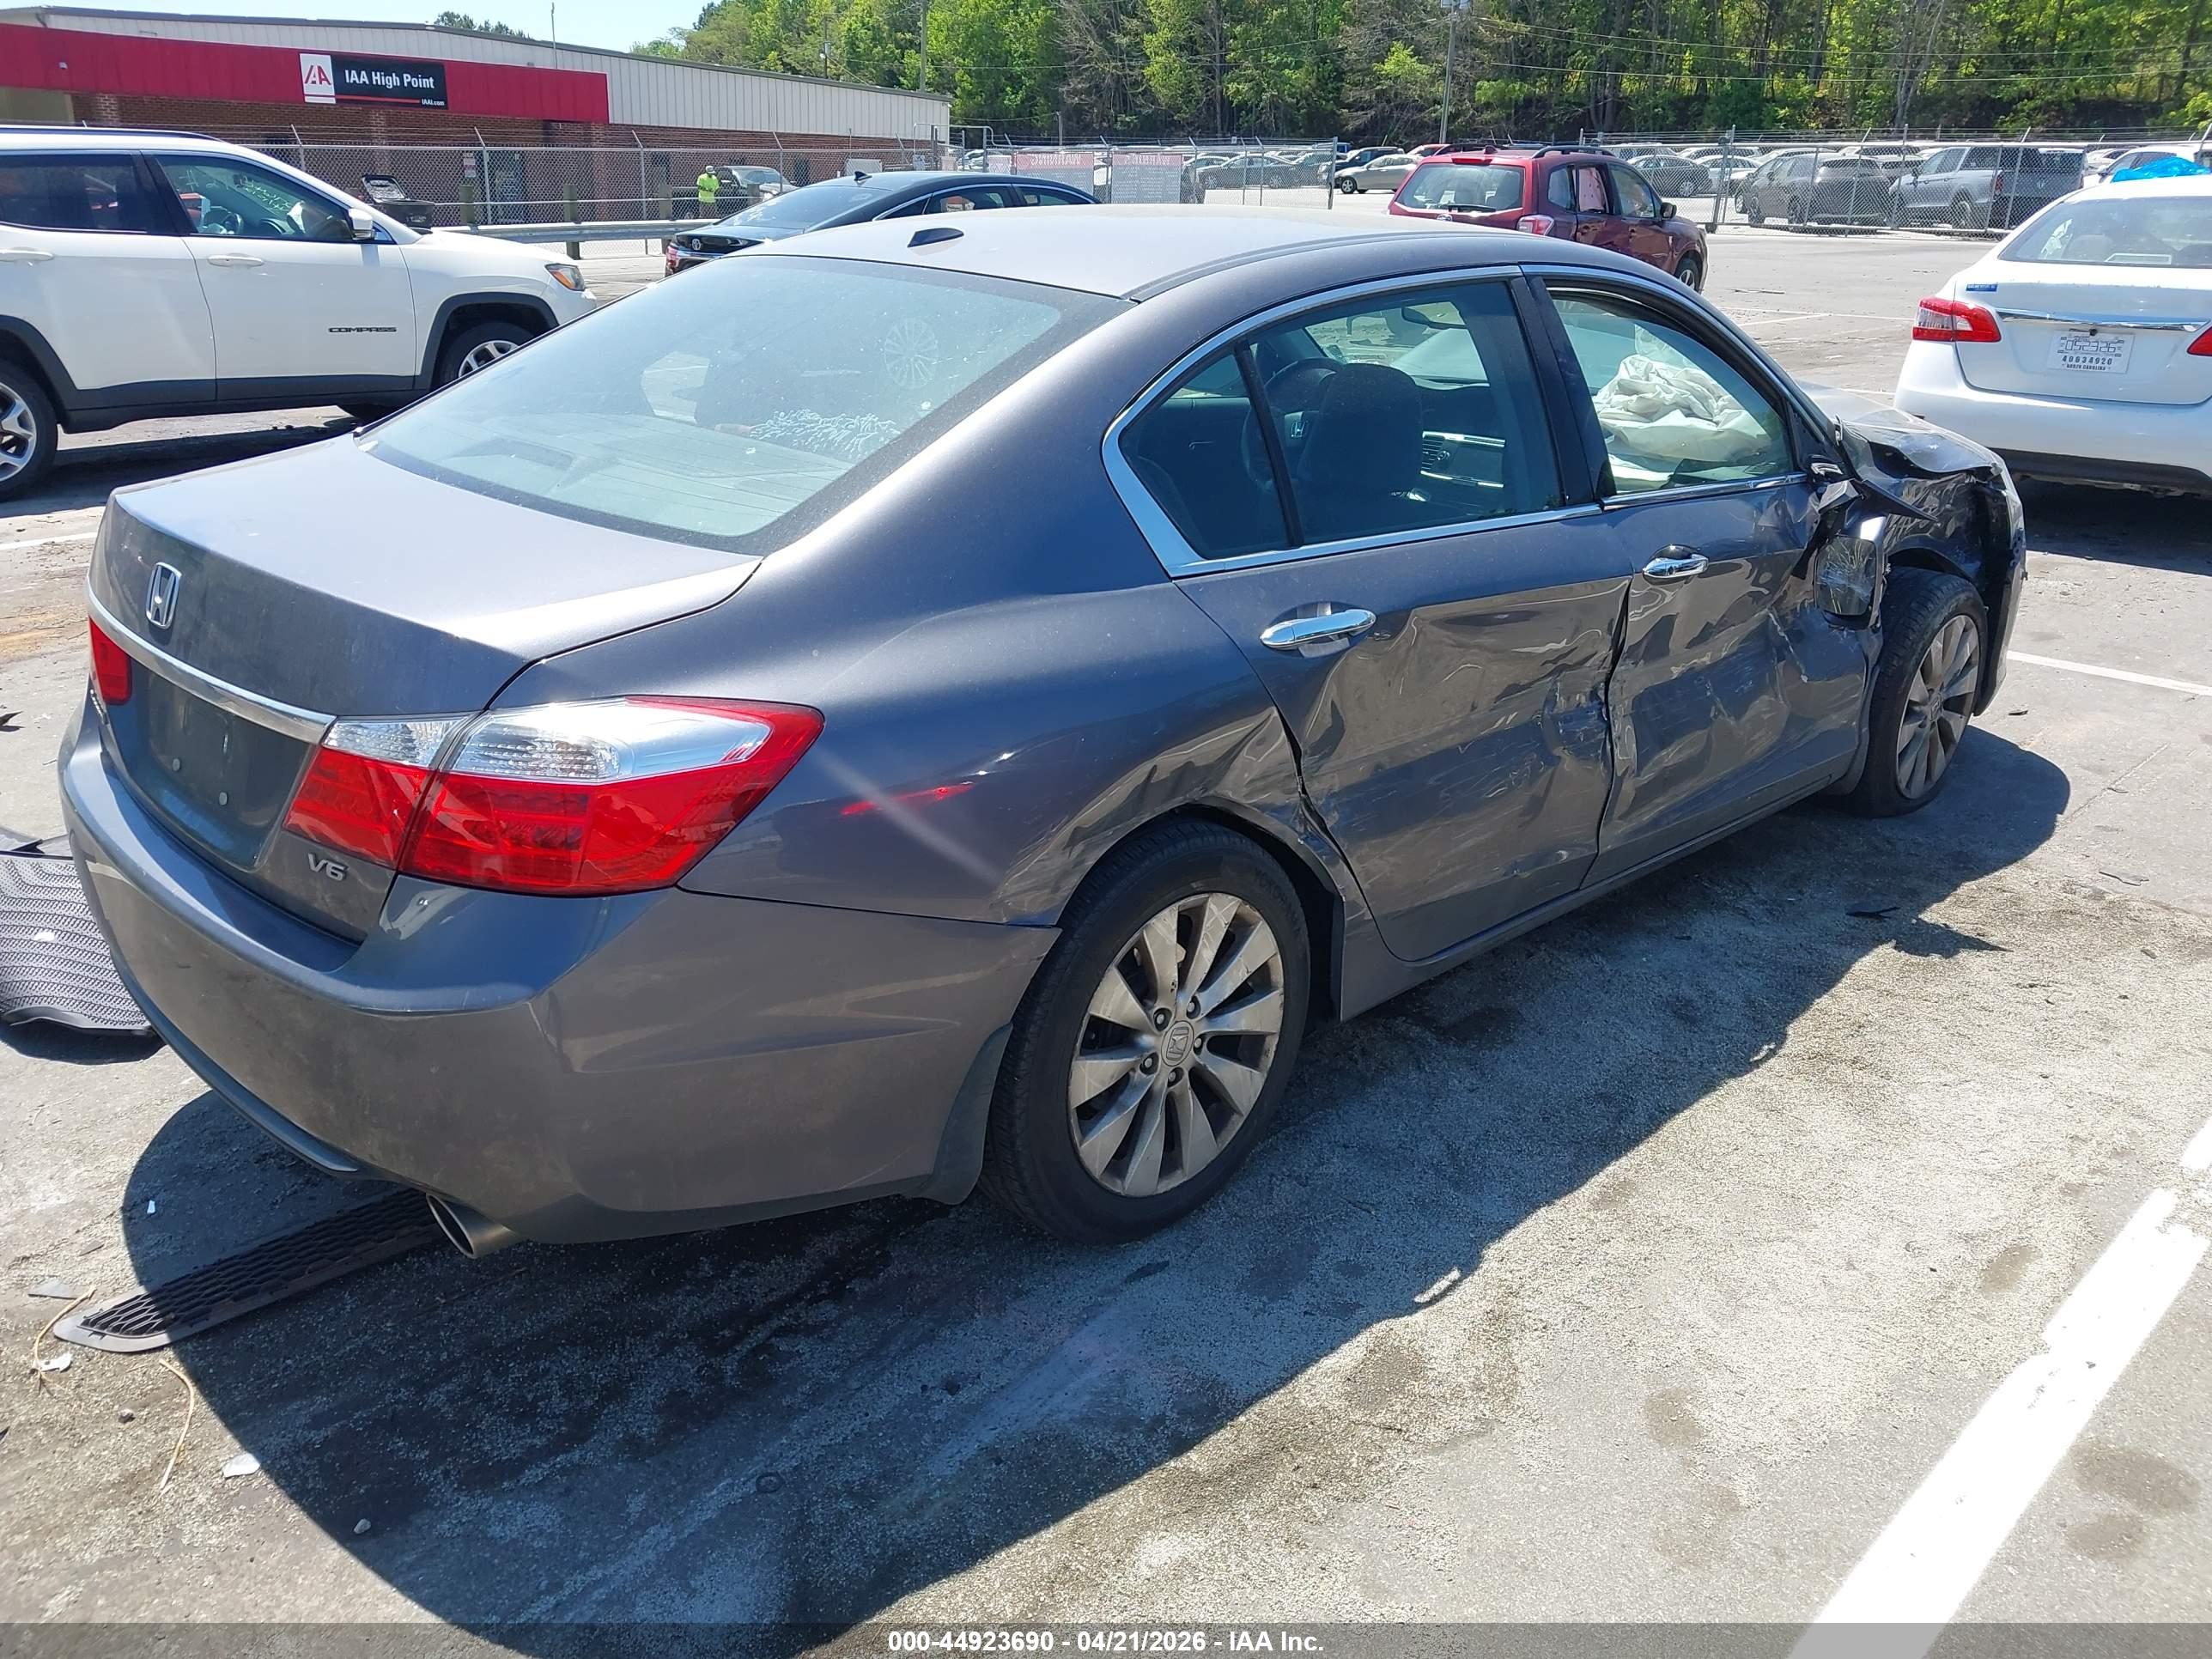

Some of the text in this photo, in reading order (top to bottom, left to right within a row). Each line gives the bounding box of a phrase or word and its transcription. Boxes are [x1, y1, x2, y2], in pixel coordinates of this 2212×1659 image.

[344, 70, 434, 88] IAA High Point
[308, 853, 346, 881] V6
